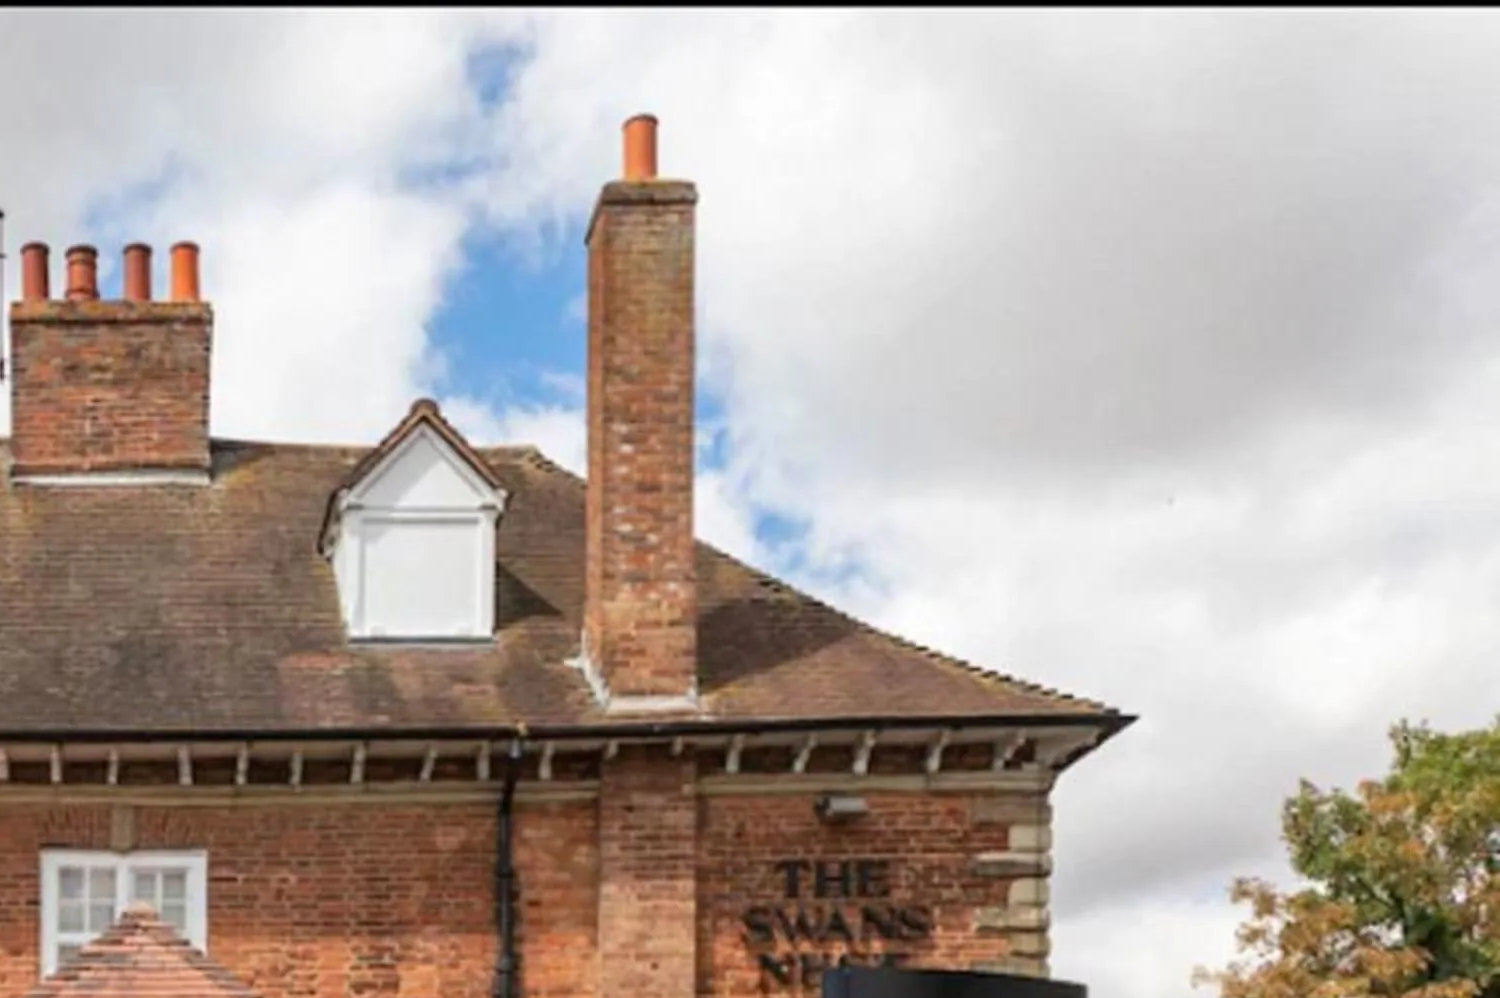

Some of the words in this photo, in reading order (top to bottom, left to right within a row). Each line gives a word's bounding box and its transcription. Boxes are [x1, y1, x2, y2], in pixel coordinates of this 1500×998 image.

[779, 860, 890, 898] THE
[743, 904, 932, 942] SWANS
[760, 952, 913, 987] NE
